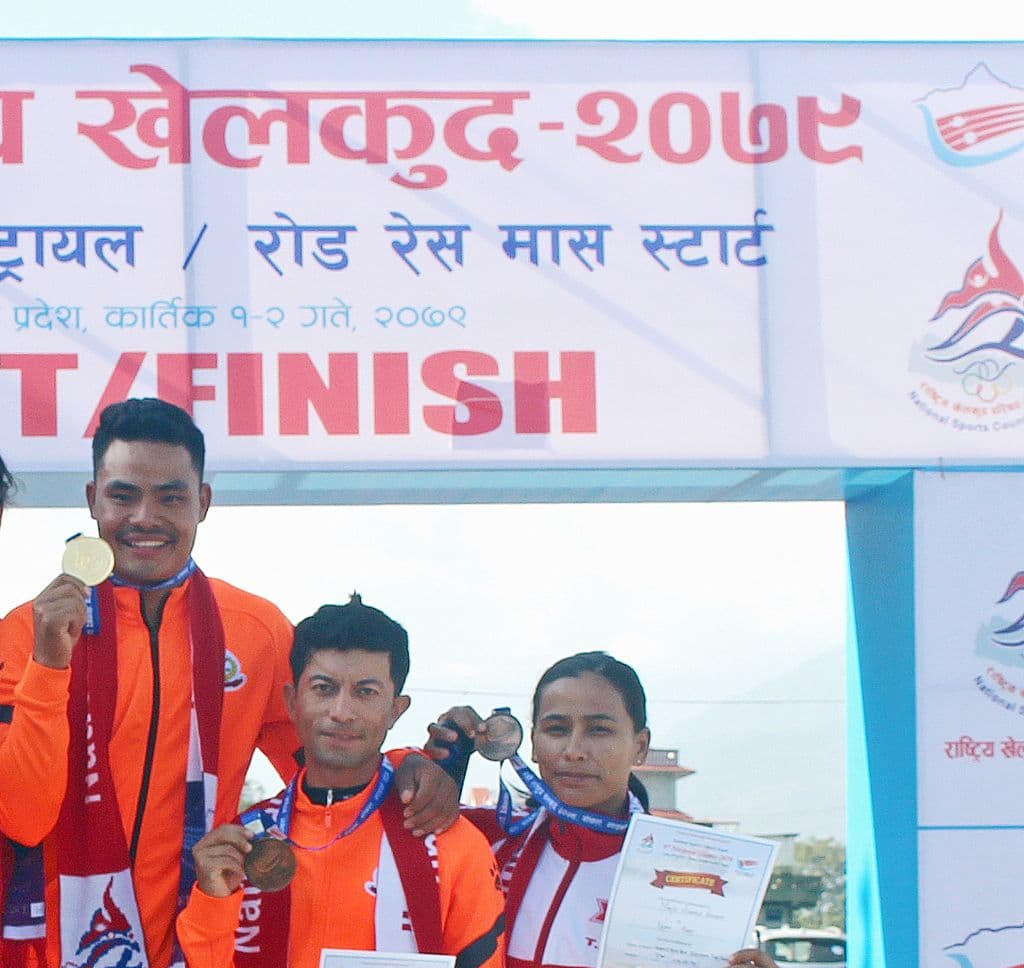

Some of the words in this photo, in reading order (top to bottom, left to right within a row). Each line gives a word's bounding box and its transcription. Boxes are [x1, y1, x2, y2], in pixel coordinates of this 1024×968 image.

[247, 211, 357, 276] रोड
[384, 211, 471, 275] रेस
[498, 223, 613, 272] मास
[640, 208, 776, 268] स्टार्ट
[104, 296, 217, 331] कार्तिक
